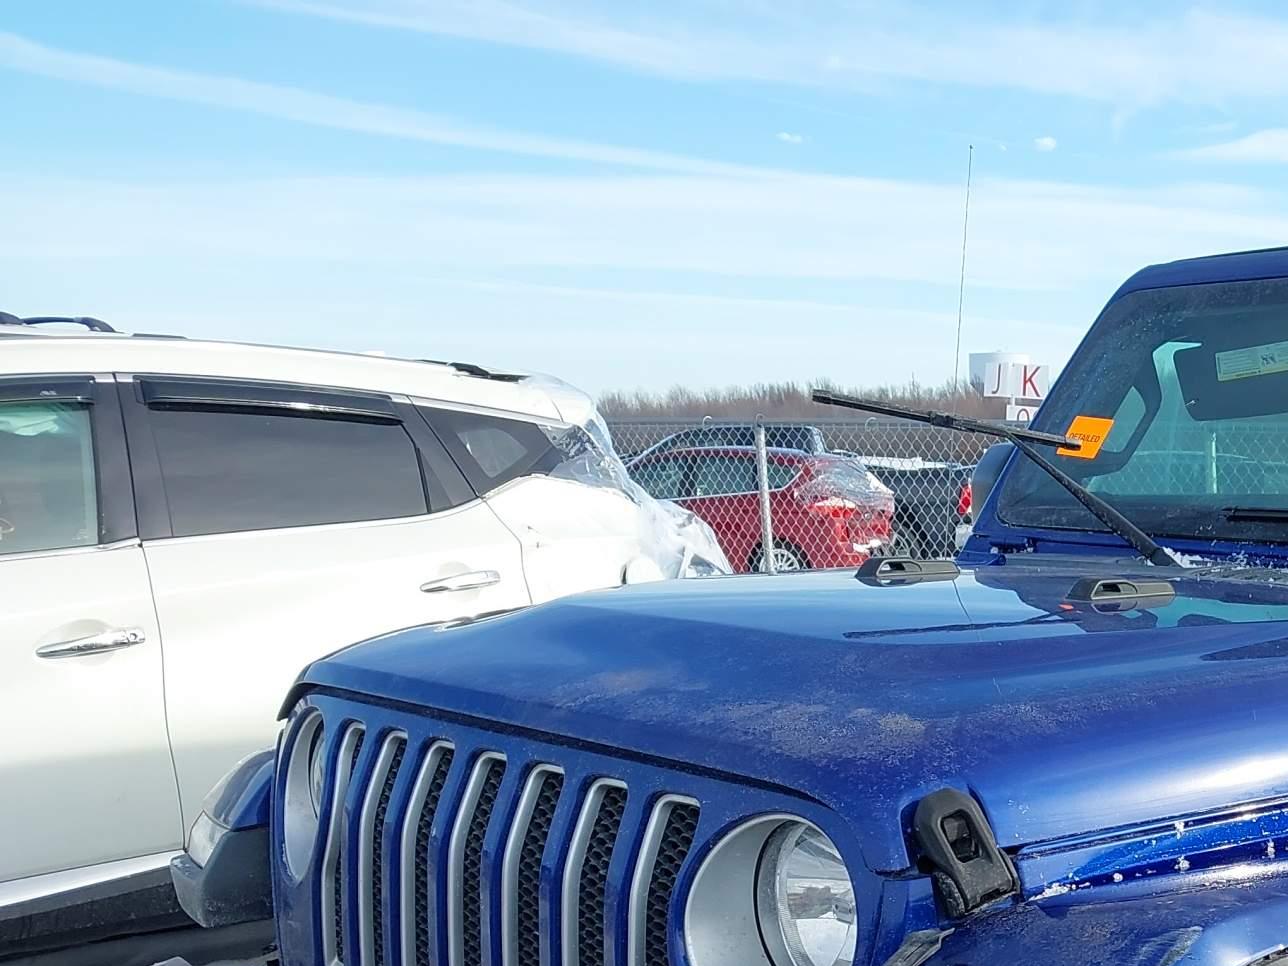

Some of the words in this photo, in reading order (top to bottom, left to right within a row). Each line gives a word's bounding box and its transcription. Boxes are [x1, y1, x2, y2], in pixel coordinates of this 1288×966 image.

[991, 363, 1001, 394] J
[1022, 364, 1041, 397] K
[1069, 432, 1101, 443] DETAILED
